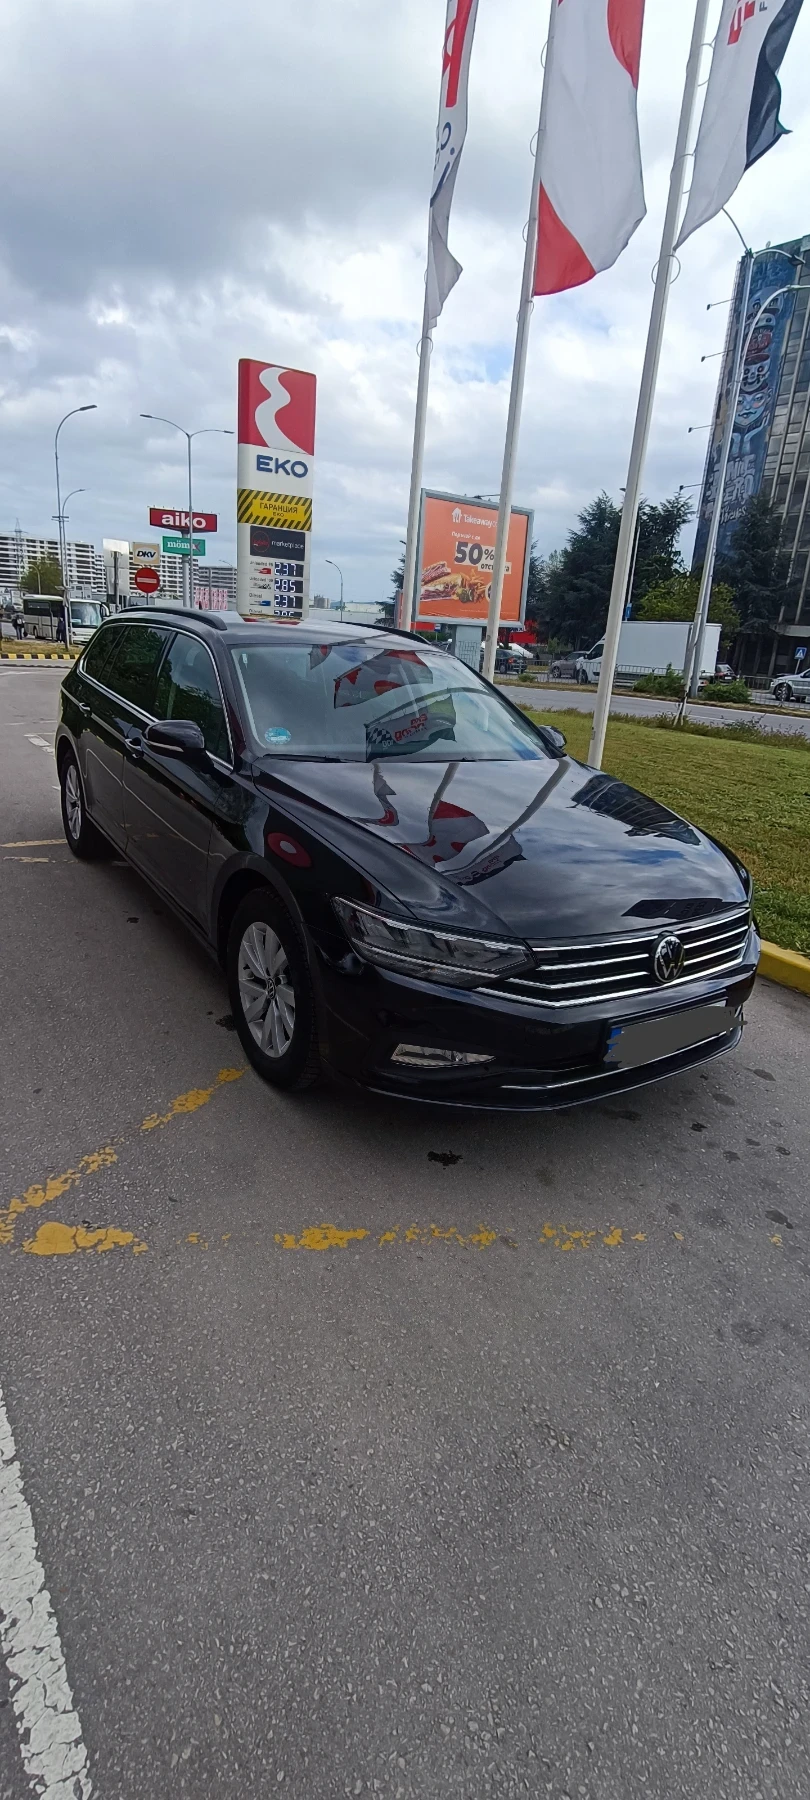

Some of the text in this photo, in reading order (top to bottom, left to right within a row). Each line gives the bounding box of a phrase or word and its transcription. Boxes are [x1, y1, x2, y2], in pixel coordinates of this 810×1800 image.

[256, 454, 308, 478] EKO
[259, 502, 298, 514] ГАРАНЦИЯ
[161, 512, 206, 528] aiko
[136, 549, 157, 559] DKV
[454, 541, 495, 565] 50%
